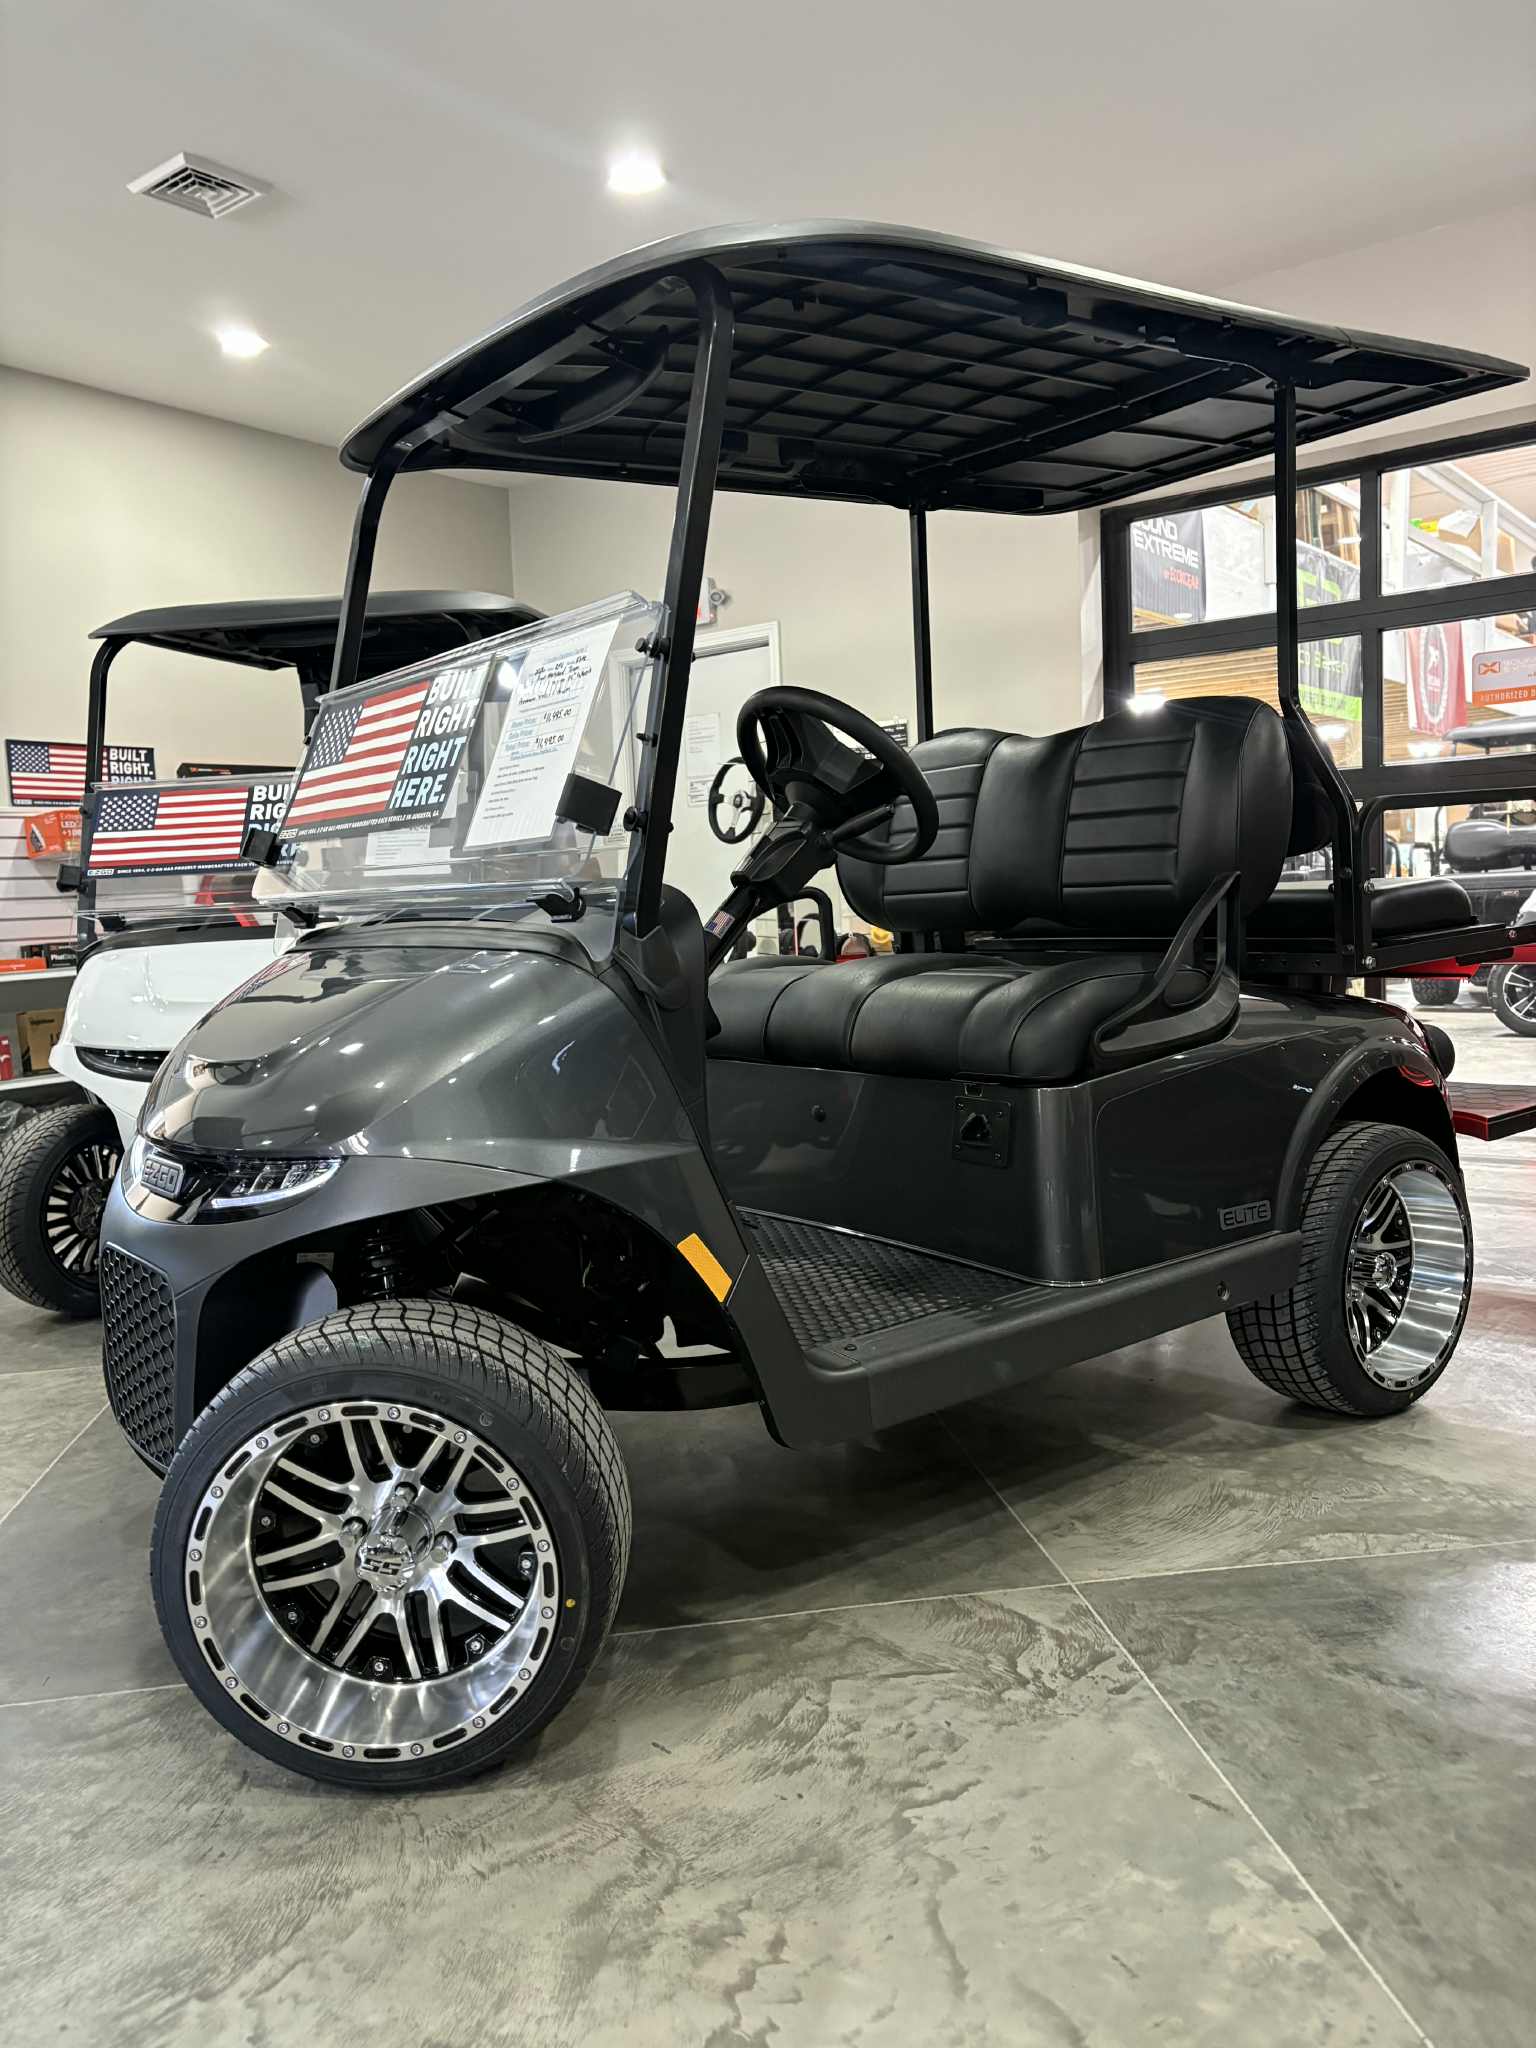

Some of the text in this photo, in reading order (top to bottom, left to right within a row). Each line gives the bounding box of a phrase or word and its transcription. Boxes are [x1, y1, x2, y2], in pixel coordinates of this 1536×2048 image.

[1132, 528, 1200, 569] EXTREME
[426, 666, 489, 706] BUILT
[414, 698, 480, 739] RIGHT.
[109, 748, 148, 762] BUILT
[109, 761, 154, 775] RIGHT.
[401, 736, 467, 775] RIGHT
[388, 773, 448, 810] HERE.
[1223, 1203, 1268, 1226] ELITE
